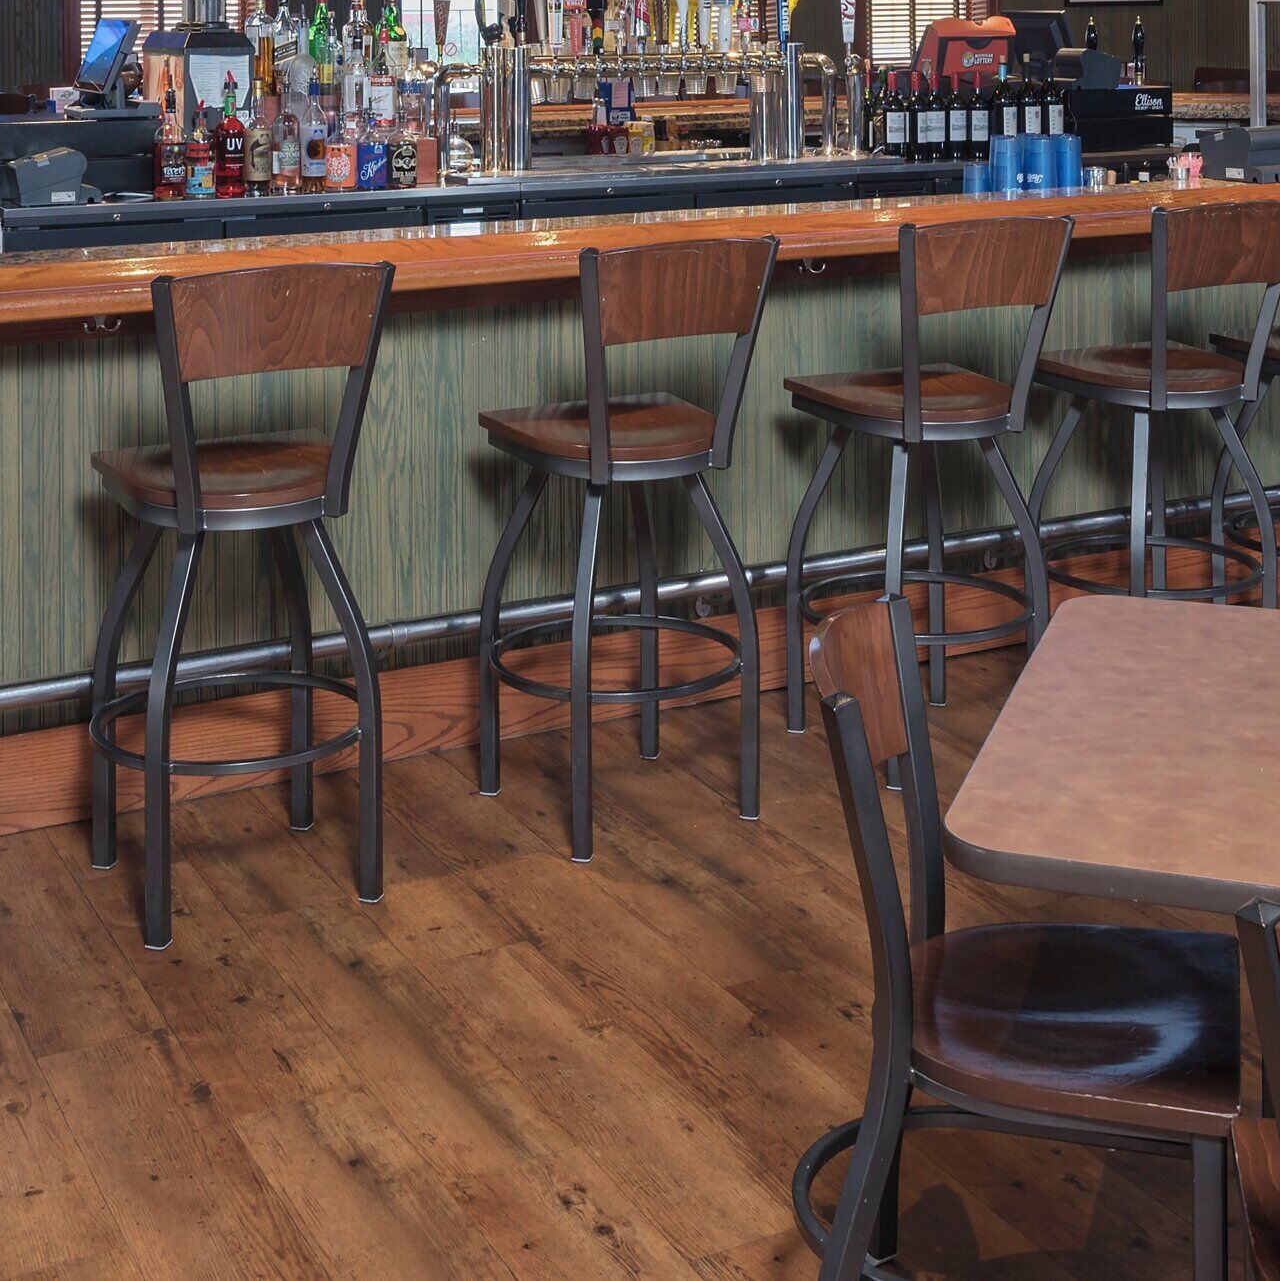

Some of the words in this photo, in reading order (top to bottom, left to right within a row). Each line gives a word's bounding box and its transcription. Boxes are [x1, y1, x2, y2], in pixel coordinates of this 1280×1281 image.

[974, 57, 994, 65] LOTTERY
[1134, 93, 1163, 107] Ellison
[226, 137, 243, 150] UV
